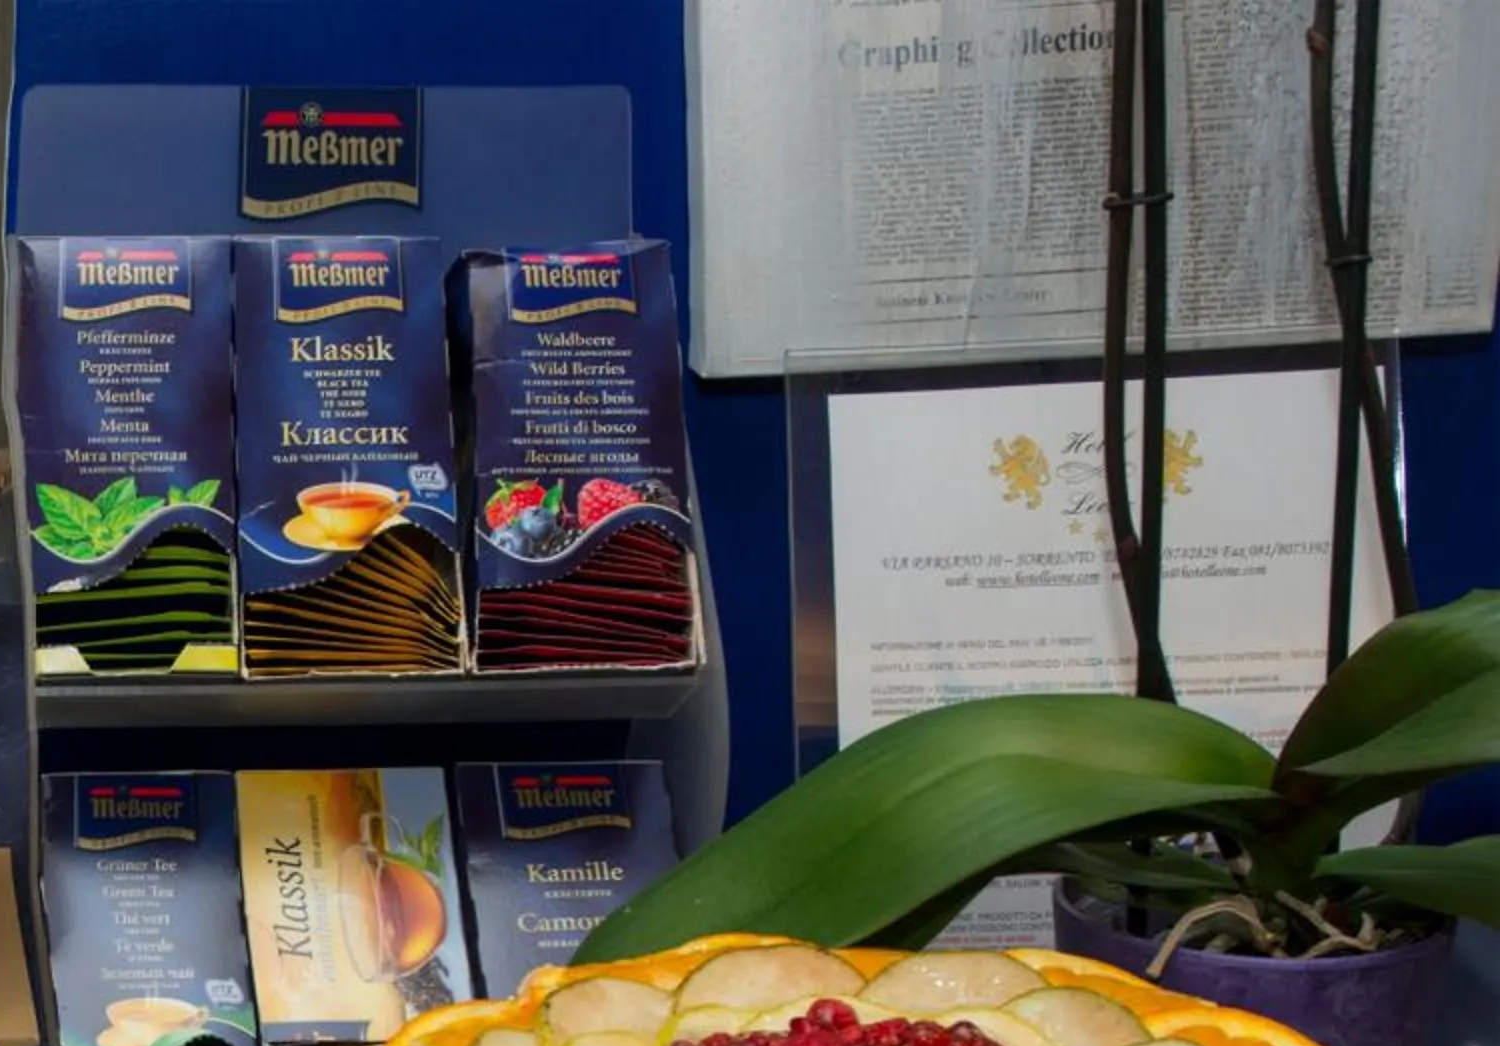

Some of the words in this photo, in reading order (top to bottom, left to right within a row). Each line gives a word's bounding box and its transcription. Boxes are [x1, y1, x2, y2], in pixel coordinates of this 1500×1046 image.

[837, 36, 973, 72] Graphig
[261, 129, 404, 166] Meßmer
[77, 262, 180, 286] Meßmer
[289, 263, 389, 287] Meßmer
[521, 264, 622, 288] Meßmer
[77, 329, 176, 346] Pfefferminze
[536, 332, 617, 347] Waldbeere
[291, 335, 395, 362] Klassik
[79, 359, 171, 377] Peppermint
[529, 361, 568, 375] Wild
[572, 361, 626, 375] Berries
[94, 388, 156, 403] Menthe
[524, 391, 571, 405] Fruits
[574, 391, 599, 405] des
[602, 390, 636, 405] bois
[100, 418, 150, 433] Menta
[280, 420, 409, 446] Классик
[524, 420, 570, 434] Frutti
[573, 420, 589, 434] di
[592, 420, 637, 434] bosco
[90, 797, 184, 819] Meßmer
[514, 787, 615, 808] Meßmer
[153, 857, 178, 872] Tee
[525, 861, 625, 884] Kamille
[266, 836, 313, 960] Klassik
